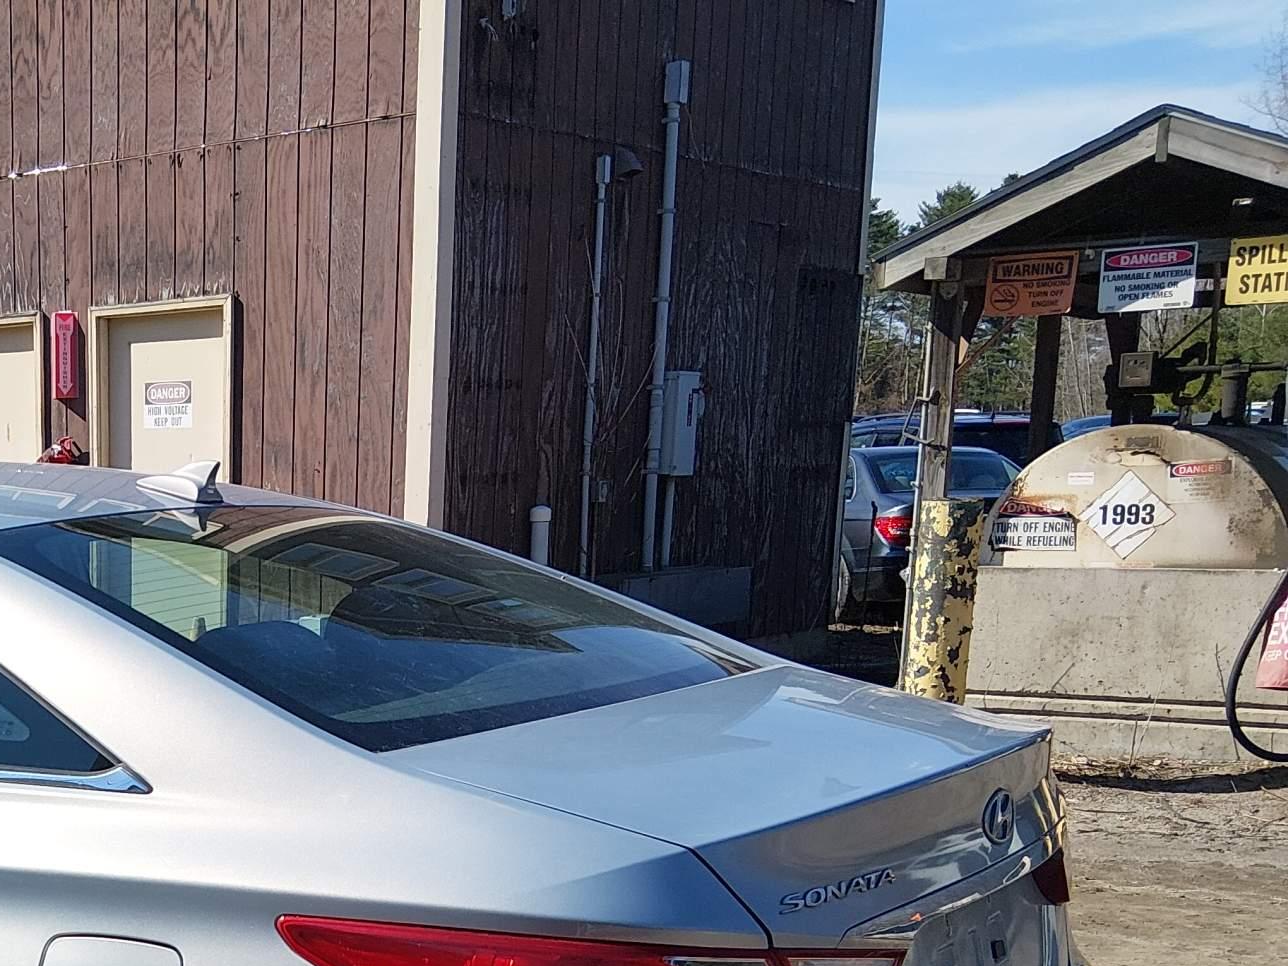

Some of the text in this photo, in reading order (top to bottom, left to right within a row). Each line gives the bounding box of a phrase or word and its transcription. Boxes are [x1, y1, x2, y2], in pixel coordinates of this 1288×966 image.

[1120, 251, 1178, 266] DANGER
[1235, 243, 1288, 266] SPILL
[1002, 262, 1064, 277] WARNING
[1102, 268, 1192, 283] FLAMMABLE MATERIAL
[1050, 289, 1065, 297] OFF
[1114, 281, 1179, 293] NO SMOKING OR
[1118, 291, 1173, 301] OPEN FLAMES
[150, 387, 186, 400] DANGER
[147, 405, 189, 416] HIGH VOLTAGE
[153, 416, 183, 427] KEEP OUT
[1178, 463, 1224, 475] DANGER
[1098, 503, 1156, 526] 1993
[996, 521, 1075, 534] TURN OFF ENGINE
[994, 535, 1075, 547] WHILE REFUELING
[778, 867, 896, 915] SONATA
